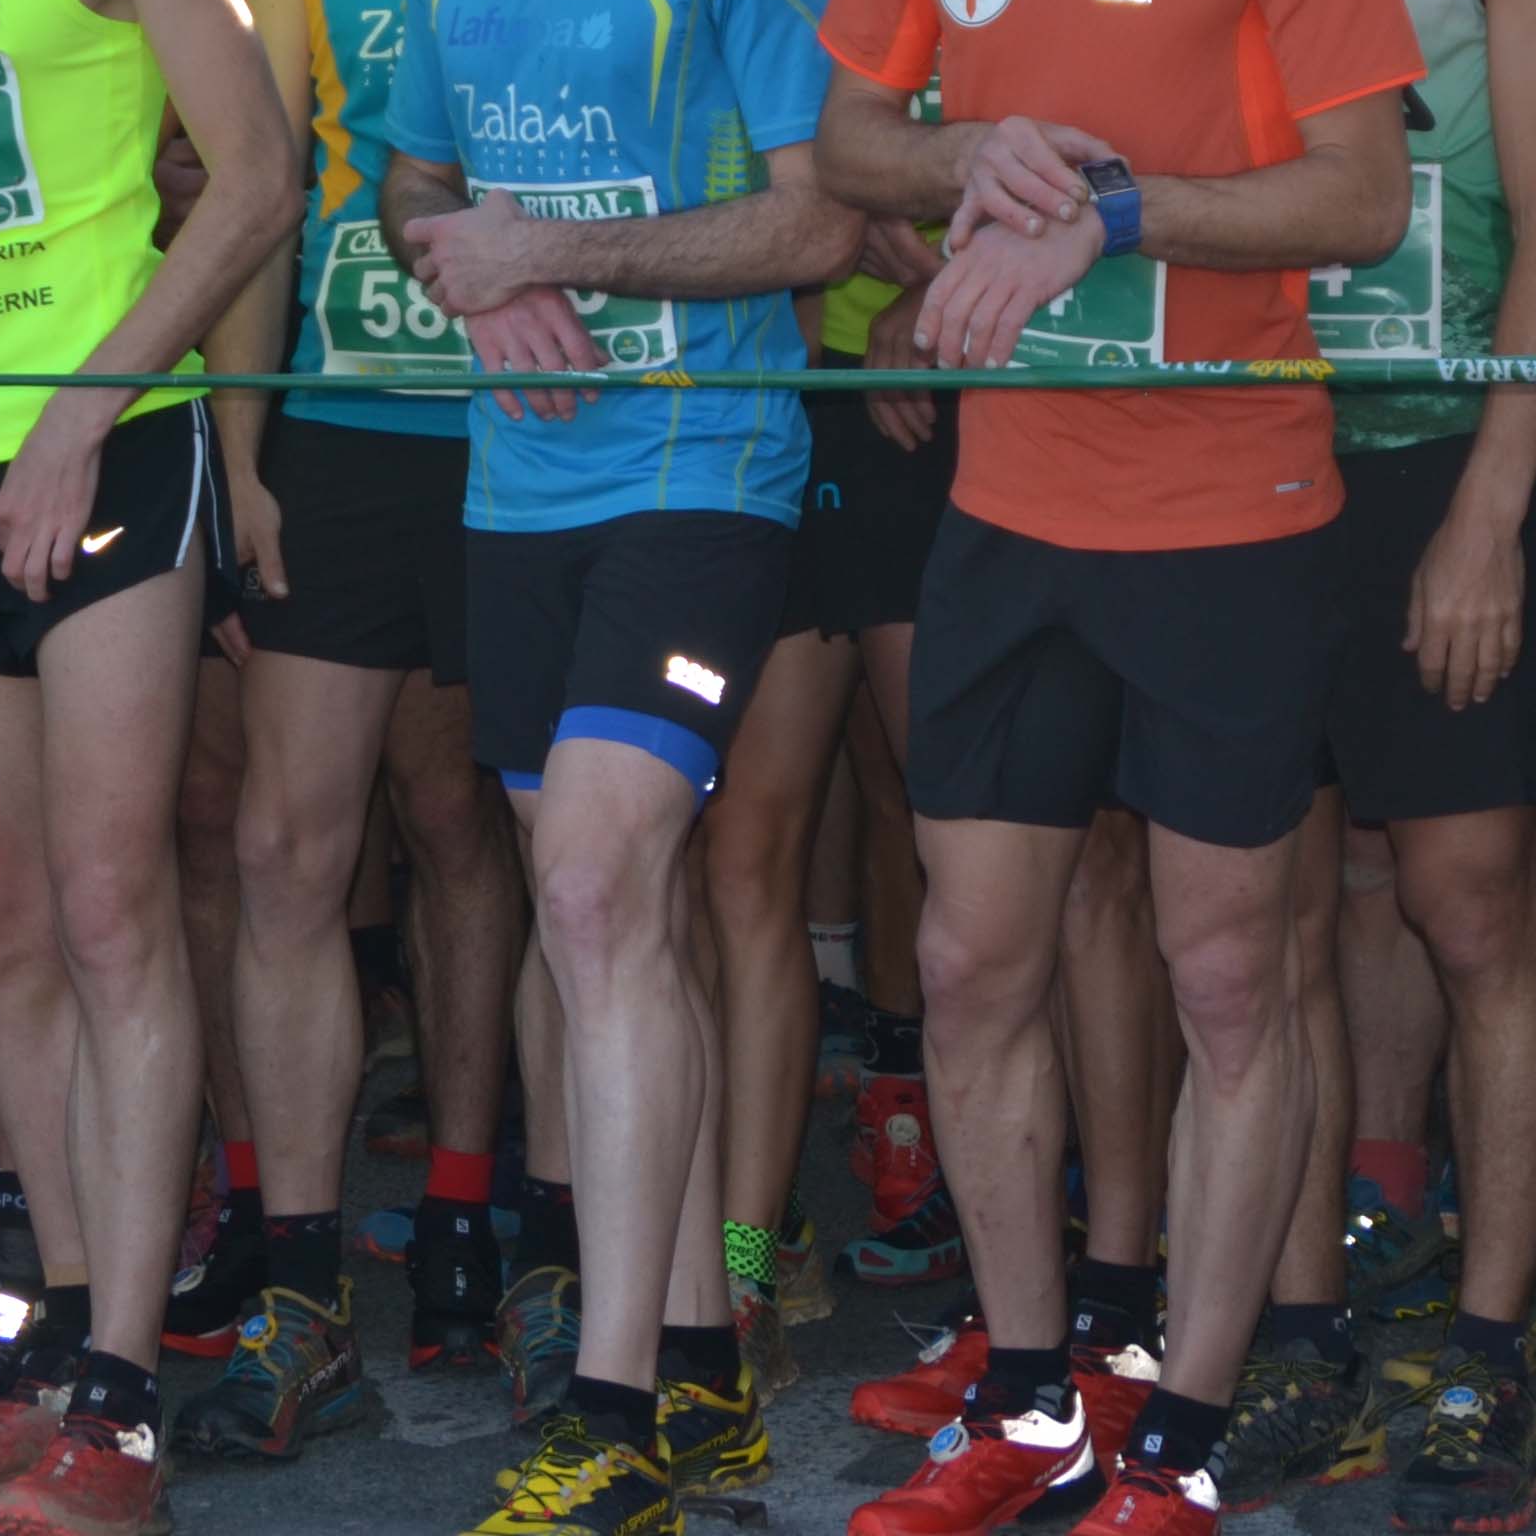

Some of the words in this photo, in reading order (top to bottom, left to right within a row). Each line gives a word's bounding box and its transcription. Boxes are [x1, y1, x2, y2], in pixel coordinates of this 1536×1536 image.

[454, 82, 618, 143] Zalain
[522, 190, 632, 221] RURAL
[349, 228, 388, 255] CA
[360, 270, 466, 340] 58
